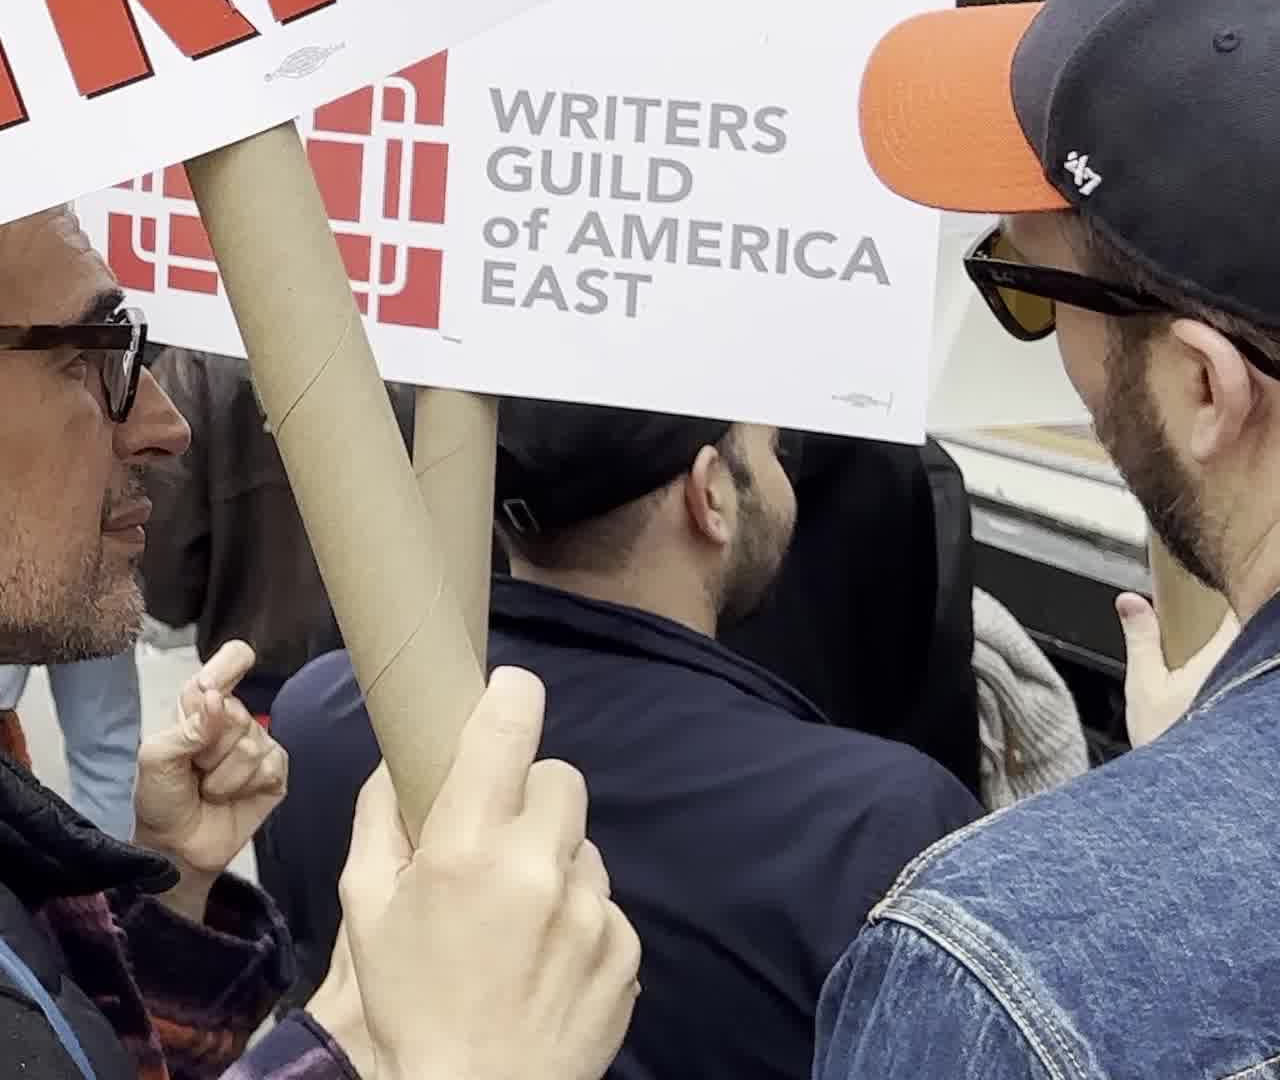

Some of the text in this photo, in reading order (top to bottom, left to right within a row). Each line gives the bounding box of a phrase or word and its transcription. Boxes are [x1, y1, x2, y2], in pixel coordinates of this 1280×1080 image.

[488, 86, 790, 155] WRITERS
[486, 145, 694, 204] GUILD
[482, 207, 892, 287] of AMERICA
[481, 259, 654, 319] EAST
